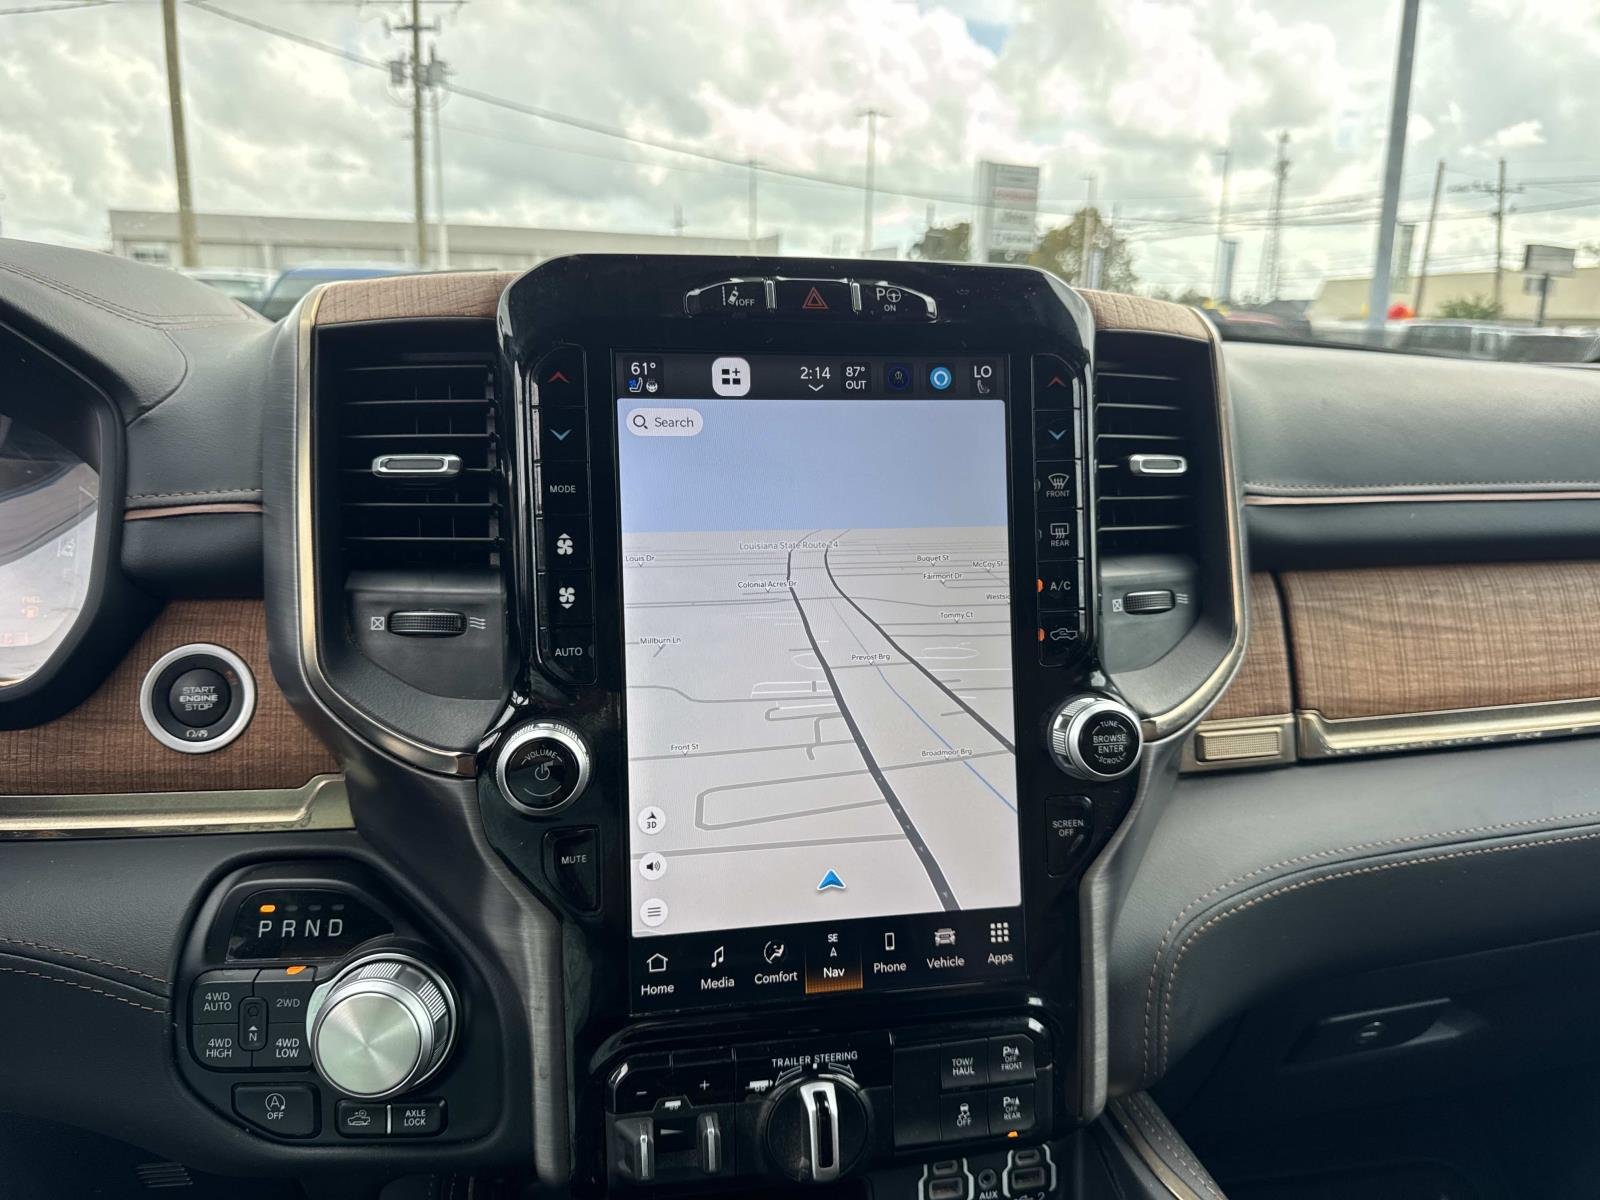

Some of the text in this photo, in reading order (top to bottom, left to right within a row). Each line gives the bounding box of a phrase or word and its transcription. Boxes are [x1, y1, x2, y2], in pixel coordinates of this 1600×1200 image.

[738, 299, 755, 307] OFF
[884, 304, 896, 312] ON
[630, 362, 656, 376] 61°
[800, 366, 831, 381] 2:14
[845, 366, 866, 378] 87°
[974, 365, 992, 378] LO
[845, 380, 867, 391] OUT
[654, 416, 694, 428] Search
[550, 485, 577, 493] MODE
[1046, 490, 1070, 498] FRONT
[739, 540, 838, 550] Louisiana State Route 24
[916, 555, 942, 563] Buquet
[738, 581, 767, 589] Colonial
[788, 580, 797, 588] Dr
[1050, 580, 1072, 591] A/C
[940, 611, 974, 620] Tommy Ct
[640, 637, 670, 645] Millburn
[554, 647, 583, 657] AUTO
[878, 653, 891, 662] Brg
[182, 686, 216, 694] START
[179, 694, 218, 703] ENGINE
[184, 703, 213, 711] STOP
[1100, 720, 1119, 728] TUNE
[1093, 734, 1127, 744] BROWSE
[921, 748, 973, 757] Broadmoor Brg
[1098, 745, 1124, 754] ENTER
[524, 749, 557, 761] VOLUME
[1098, 754, 1124, 765] SCROLL
[647, 821, 657, 829] 3D
[1052, 819, 1084, 829] SCREEN
[1058, 829, 1074, 837] OFF
[561, 854, 588, 865] MUTE
[258, 918, 343, 938] P R N D
[827, 933, 839, 943] SE
[926, 955, 965, 969] Vehicle
[987, 952, 1014, 966] Apps
[873, 961, 907, 974] Phone
[754, 971, 798, 985] Comfort
[823, 967, 845, 979] Nav
[701, 976, 735, 990] Media
[641, 984, 675, 996] Home
[205, 992, 230, 1001] 4WD
[203, 1001, 232, 1012] AUTO
[276, 998, 300, 1008] 2WD
[249, 1033, 257, 1042] N
[207, 1038, 232, 1048] 4WD
[276, 1038, 300, 1048] 4WD
[206, 1049, 232, 1058] HIGH
[276, 1048, 299, 1058] LOW
[772, 1051, 858, 1068] TRAILER STEERING
[952, 1057, 974, 1066] TOW/
[1005, 1055, 1017, 1063] OFF
[952, 1067, 975, 1076] HAUL
[1001, 1062, 1022, 1071] FRONT
[267, 1112, 284, 1120] OFF
[405, 1110, 426, 1118] AXLE
[1003, 1112, 1022, 1120] REAR
[404, 1118, 426, 1126] LOCK
[956, 1118, 972, 1127] OFF
[979, 1190, 998, 1200] AUX
